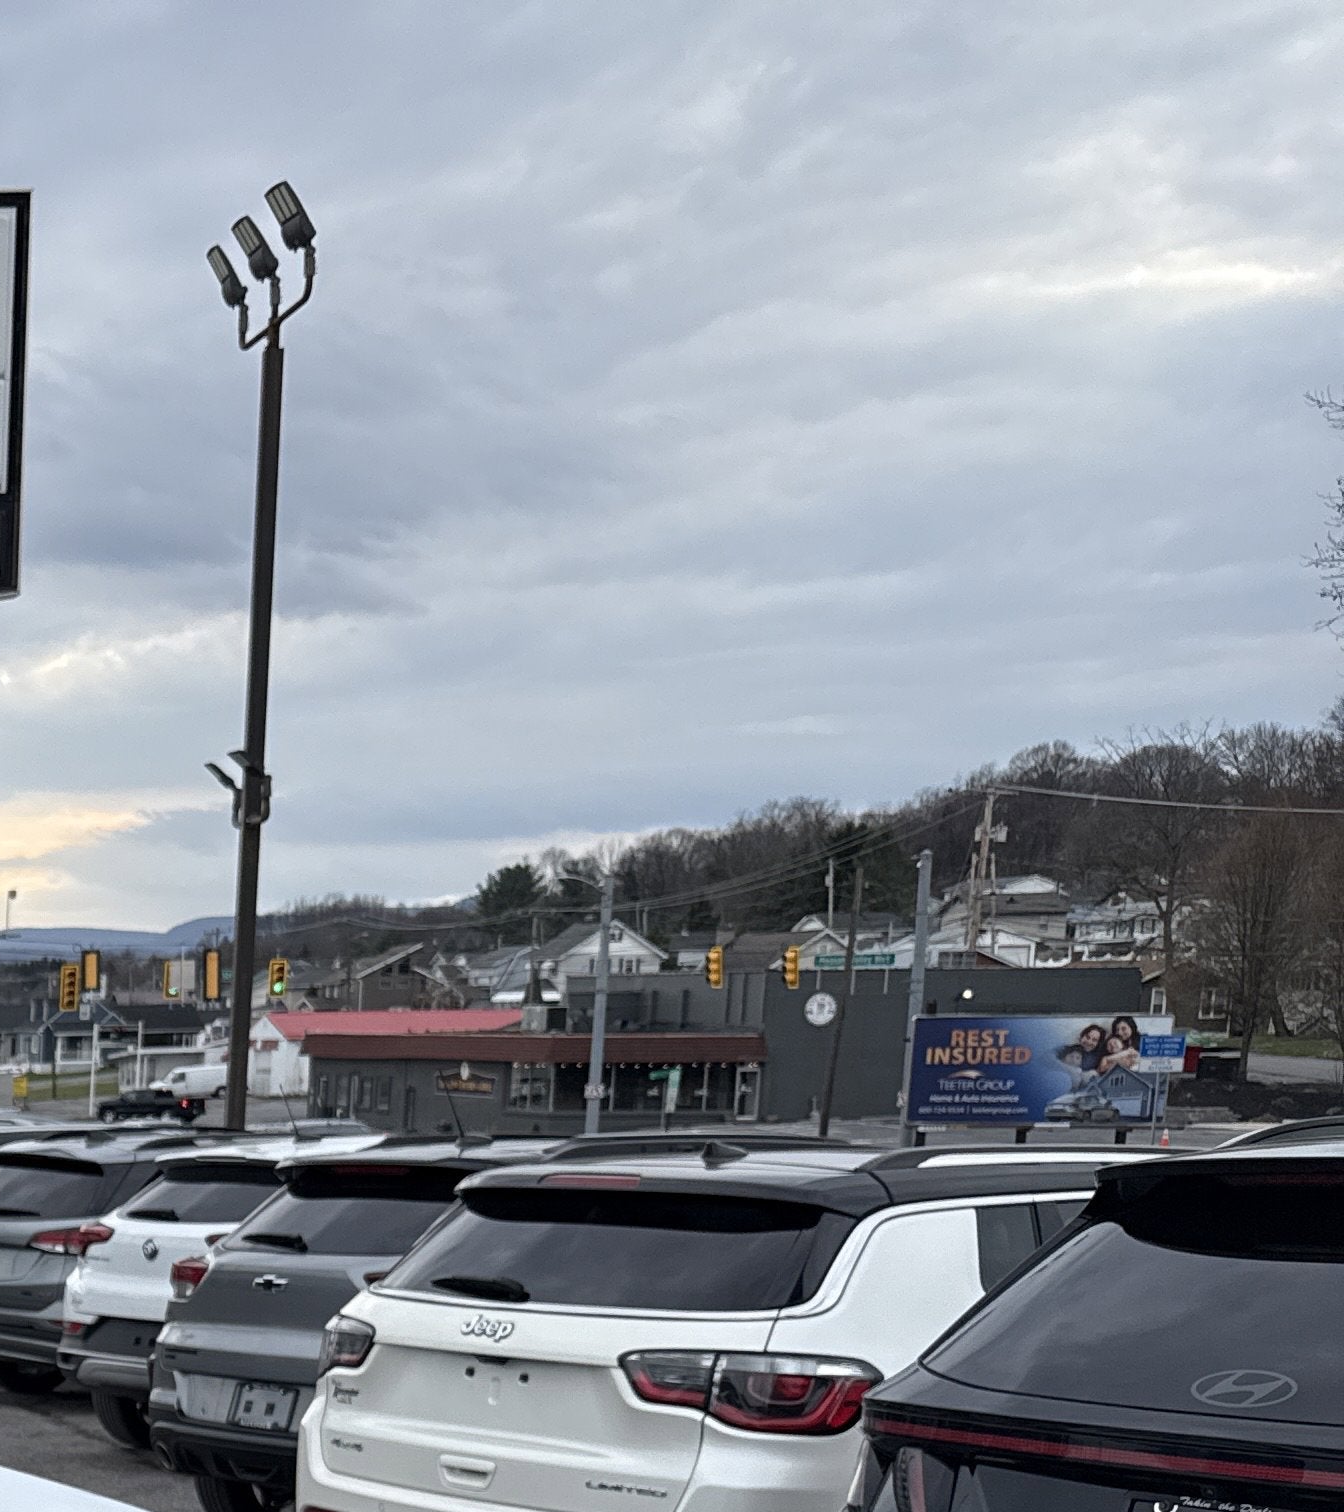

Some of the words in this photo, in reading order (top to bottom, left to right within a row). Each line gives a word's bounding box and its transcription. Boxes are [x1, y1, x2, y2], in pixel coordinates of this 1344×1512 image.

[951, 1029, 1009, 1047] REST
[925, 1047, 1032, 1065] INSURED
[976, 1079, 1015, 1091] GROUP
[460, 1314, 515, 1342] Jeep
[1218, 1501, 1236, 1512] the
